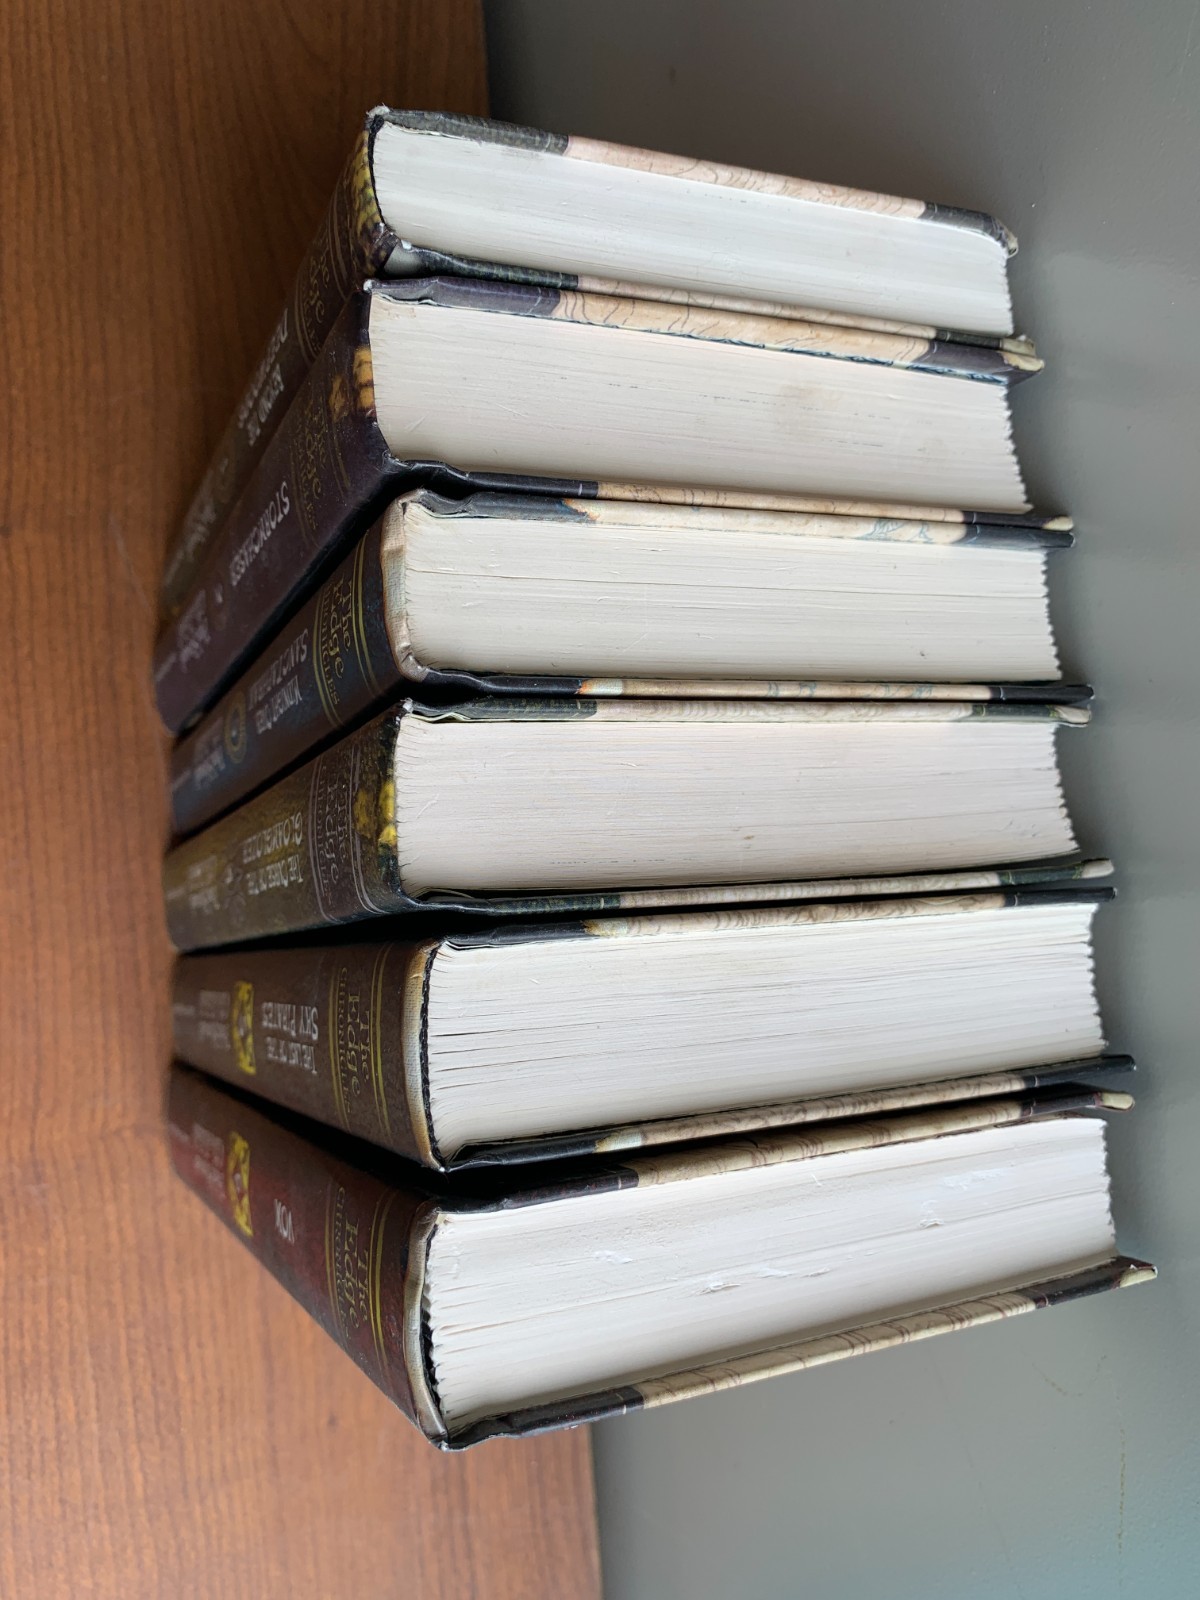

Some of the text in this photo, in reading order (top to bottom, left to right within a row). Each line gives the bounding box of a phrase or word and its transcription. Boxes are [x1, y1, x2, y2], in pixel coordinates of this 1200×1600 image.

[229, 481, 290, 587] STORMCHASER
[329, 574, 345, 679] Edge
[340, 580, 352, 652] The
[325, 779, 340, 884] Edge
[337, 783, 349, 863] The
[300, 1006, 319, 1041] SKY
[339, 967, 351, 1110] CHRONICLES
[347, 991, 361, 1096] Edge
[360, 1010, 371, 1081] The
[273, 1199, 295, 1247] VOX
[344, 1218, 360, 1328] Edge
[358, 1250, 369, 1322] The
